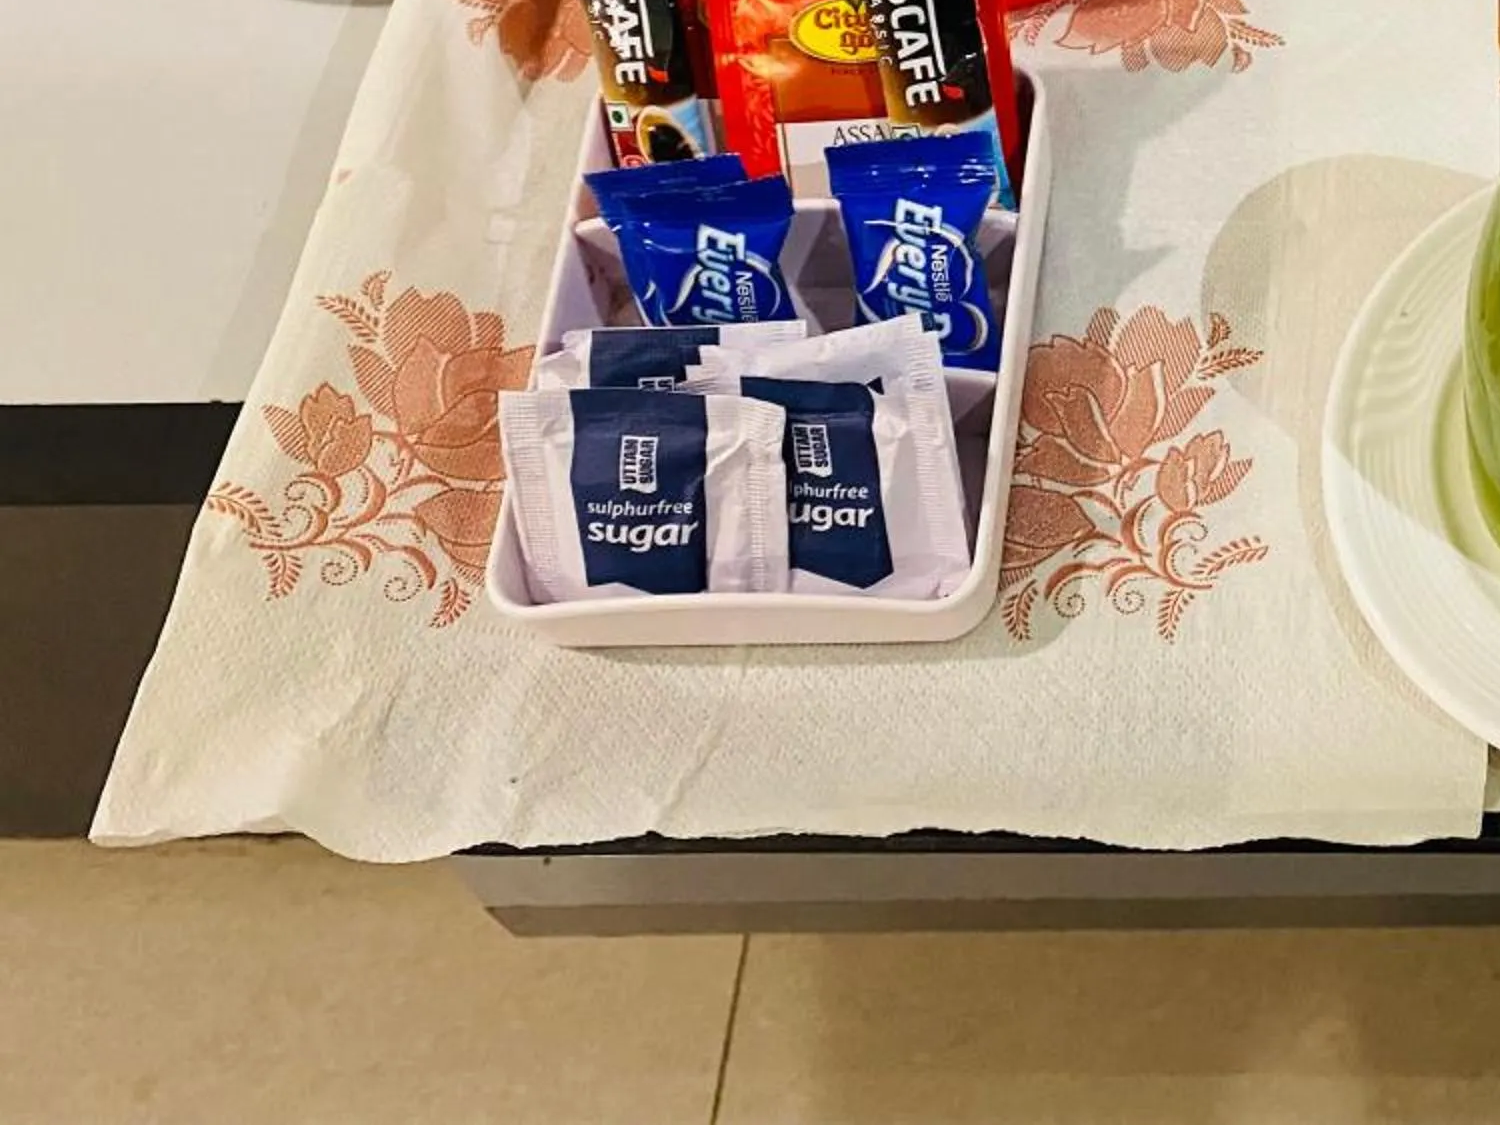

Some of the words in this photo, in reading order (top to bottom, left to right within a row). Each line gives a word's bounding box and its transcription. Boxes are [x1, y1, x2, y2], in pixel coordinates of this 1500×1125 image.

[833, 125, 894, 145] ASSA
[587, 499, 693, 519] sulphurfree
[587, 521, 699, 553] sugar
